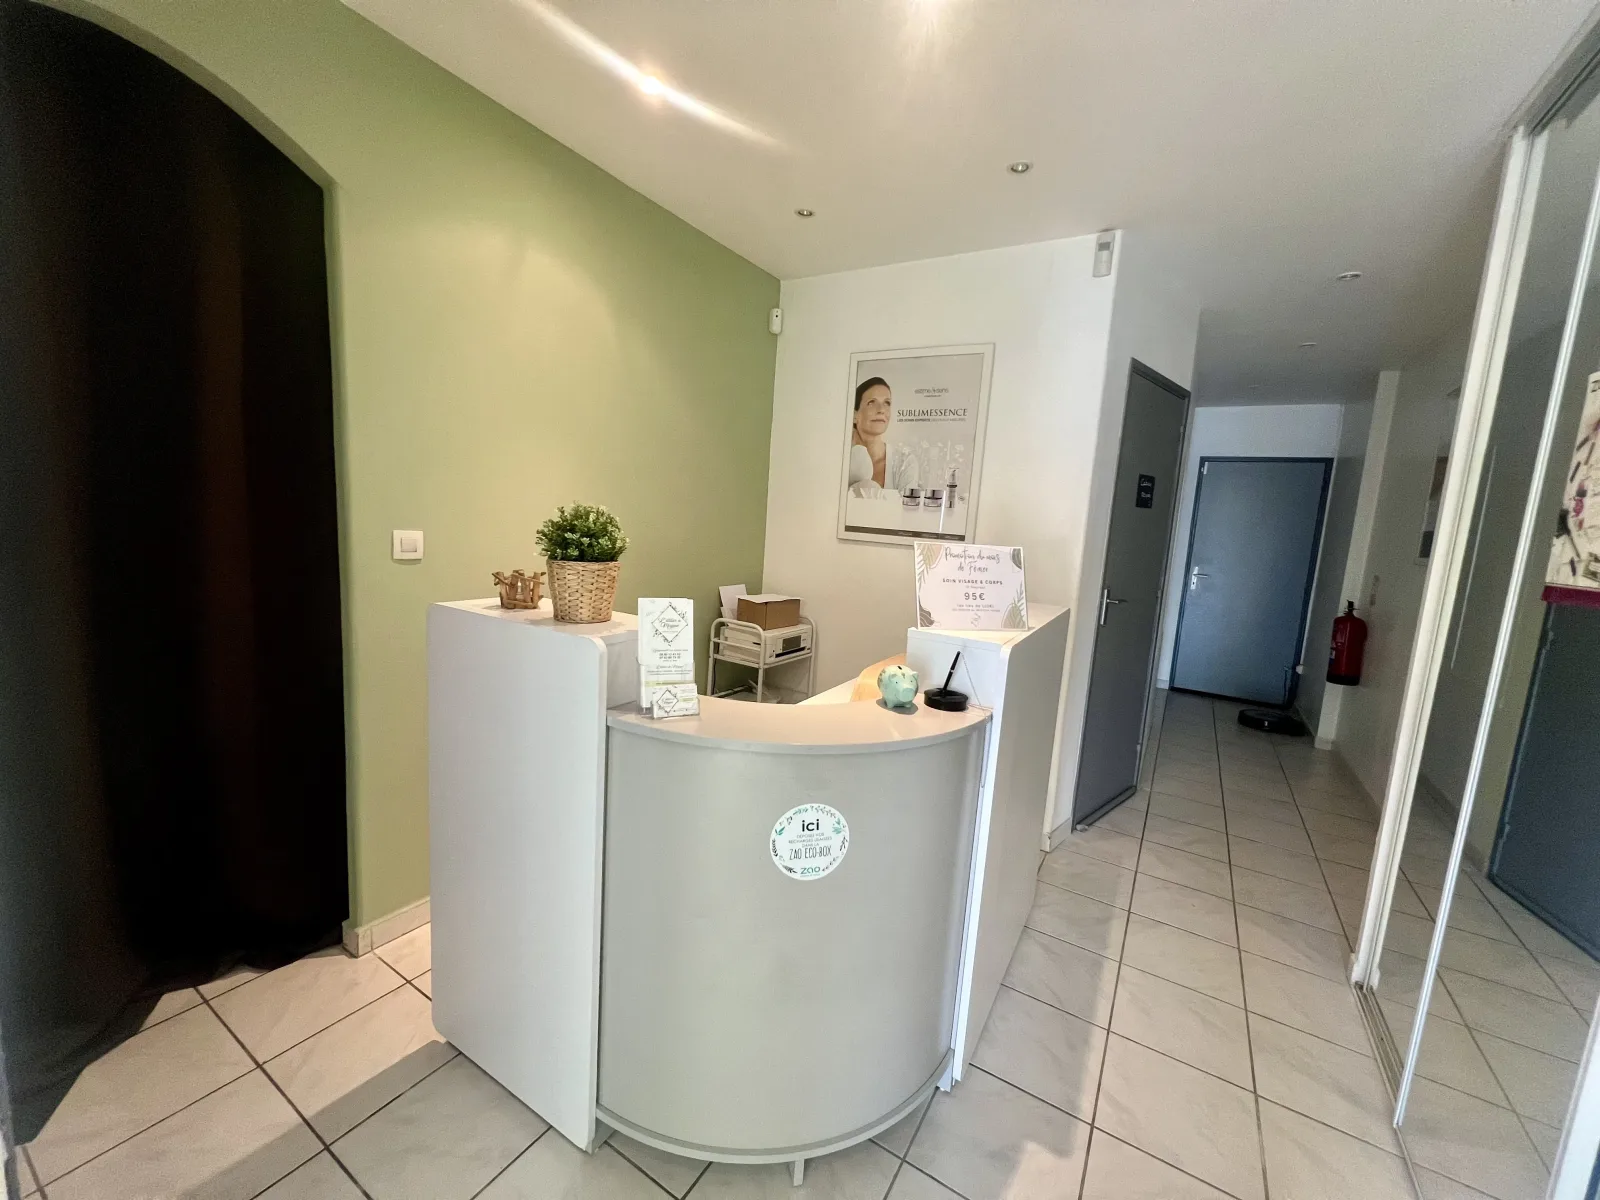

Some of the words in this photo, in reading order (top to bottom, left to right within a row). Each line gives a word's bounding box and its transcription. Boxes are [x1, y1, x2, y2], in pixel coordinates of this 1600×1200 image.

[897, 408, 968, 417] SUBLIMESSENCE
[957, 561, 964, 571] de
[964, 592, 985, 601] 95€
[802, 819, 820, 832] ici
[790, 848, 802, 860] ZAO
[805, 845, 832, 859] ECO-BOX
[800, 866, 820, 874] zao
